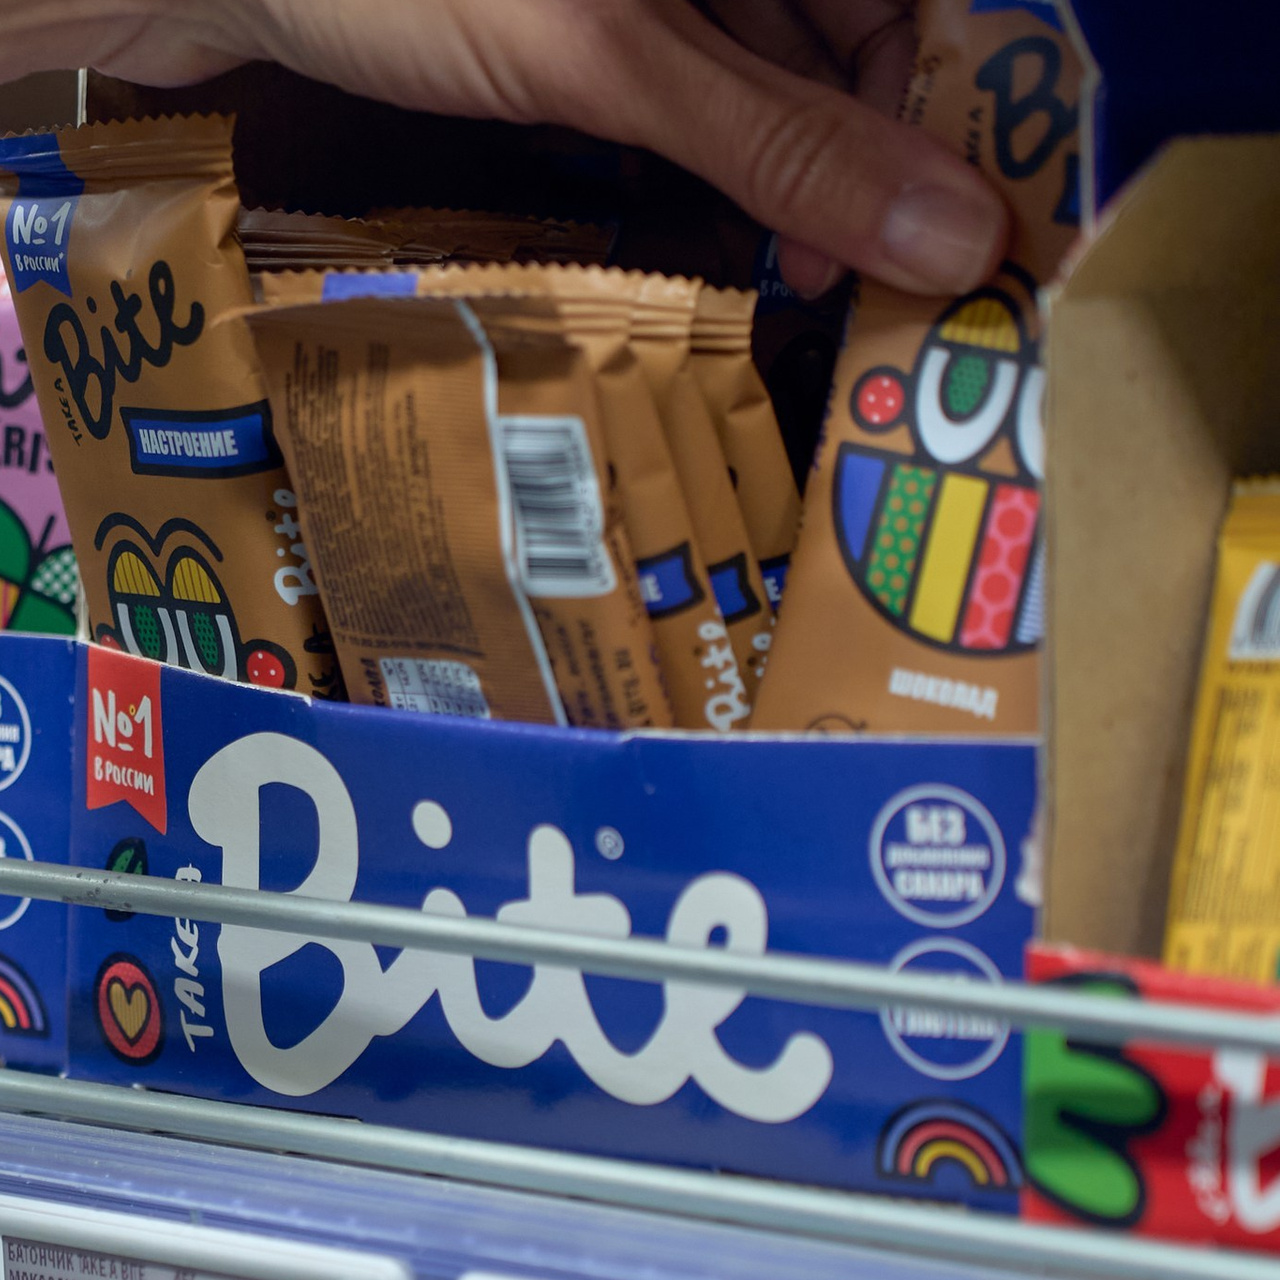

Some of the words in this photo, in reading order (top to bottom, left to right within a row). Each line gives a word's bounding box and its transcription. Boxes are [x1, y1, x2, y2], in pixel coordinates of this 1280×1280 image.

[10, 199, 71, 245] №1
[15, 252, 26, 271] В
[44, 259, 205, 440] Bite
[53, 376, 66, 394] A
[61, 396, 84, 448] TAKE
[138, 427, 239, 459] НАСТРОЕНИЕ
[889, 667, 999, 722] ШОКОЛАД
[92, 687, 153, 759] №1
[93, 756, 104, 780] В
[105, 759, 154, 796] РОССИИ
[905, 807, 966, 844] БЕЗ
[186, 728, 834, 1123] Bite
[172, 914, 220, 1054] TAKE
[7, 1242, 73, 1271] БАТОНЧИК
